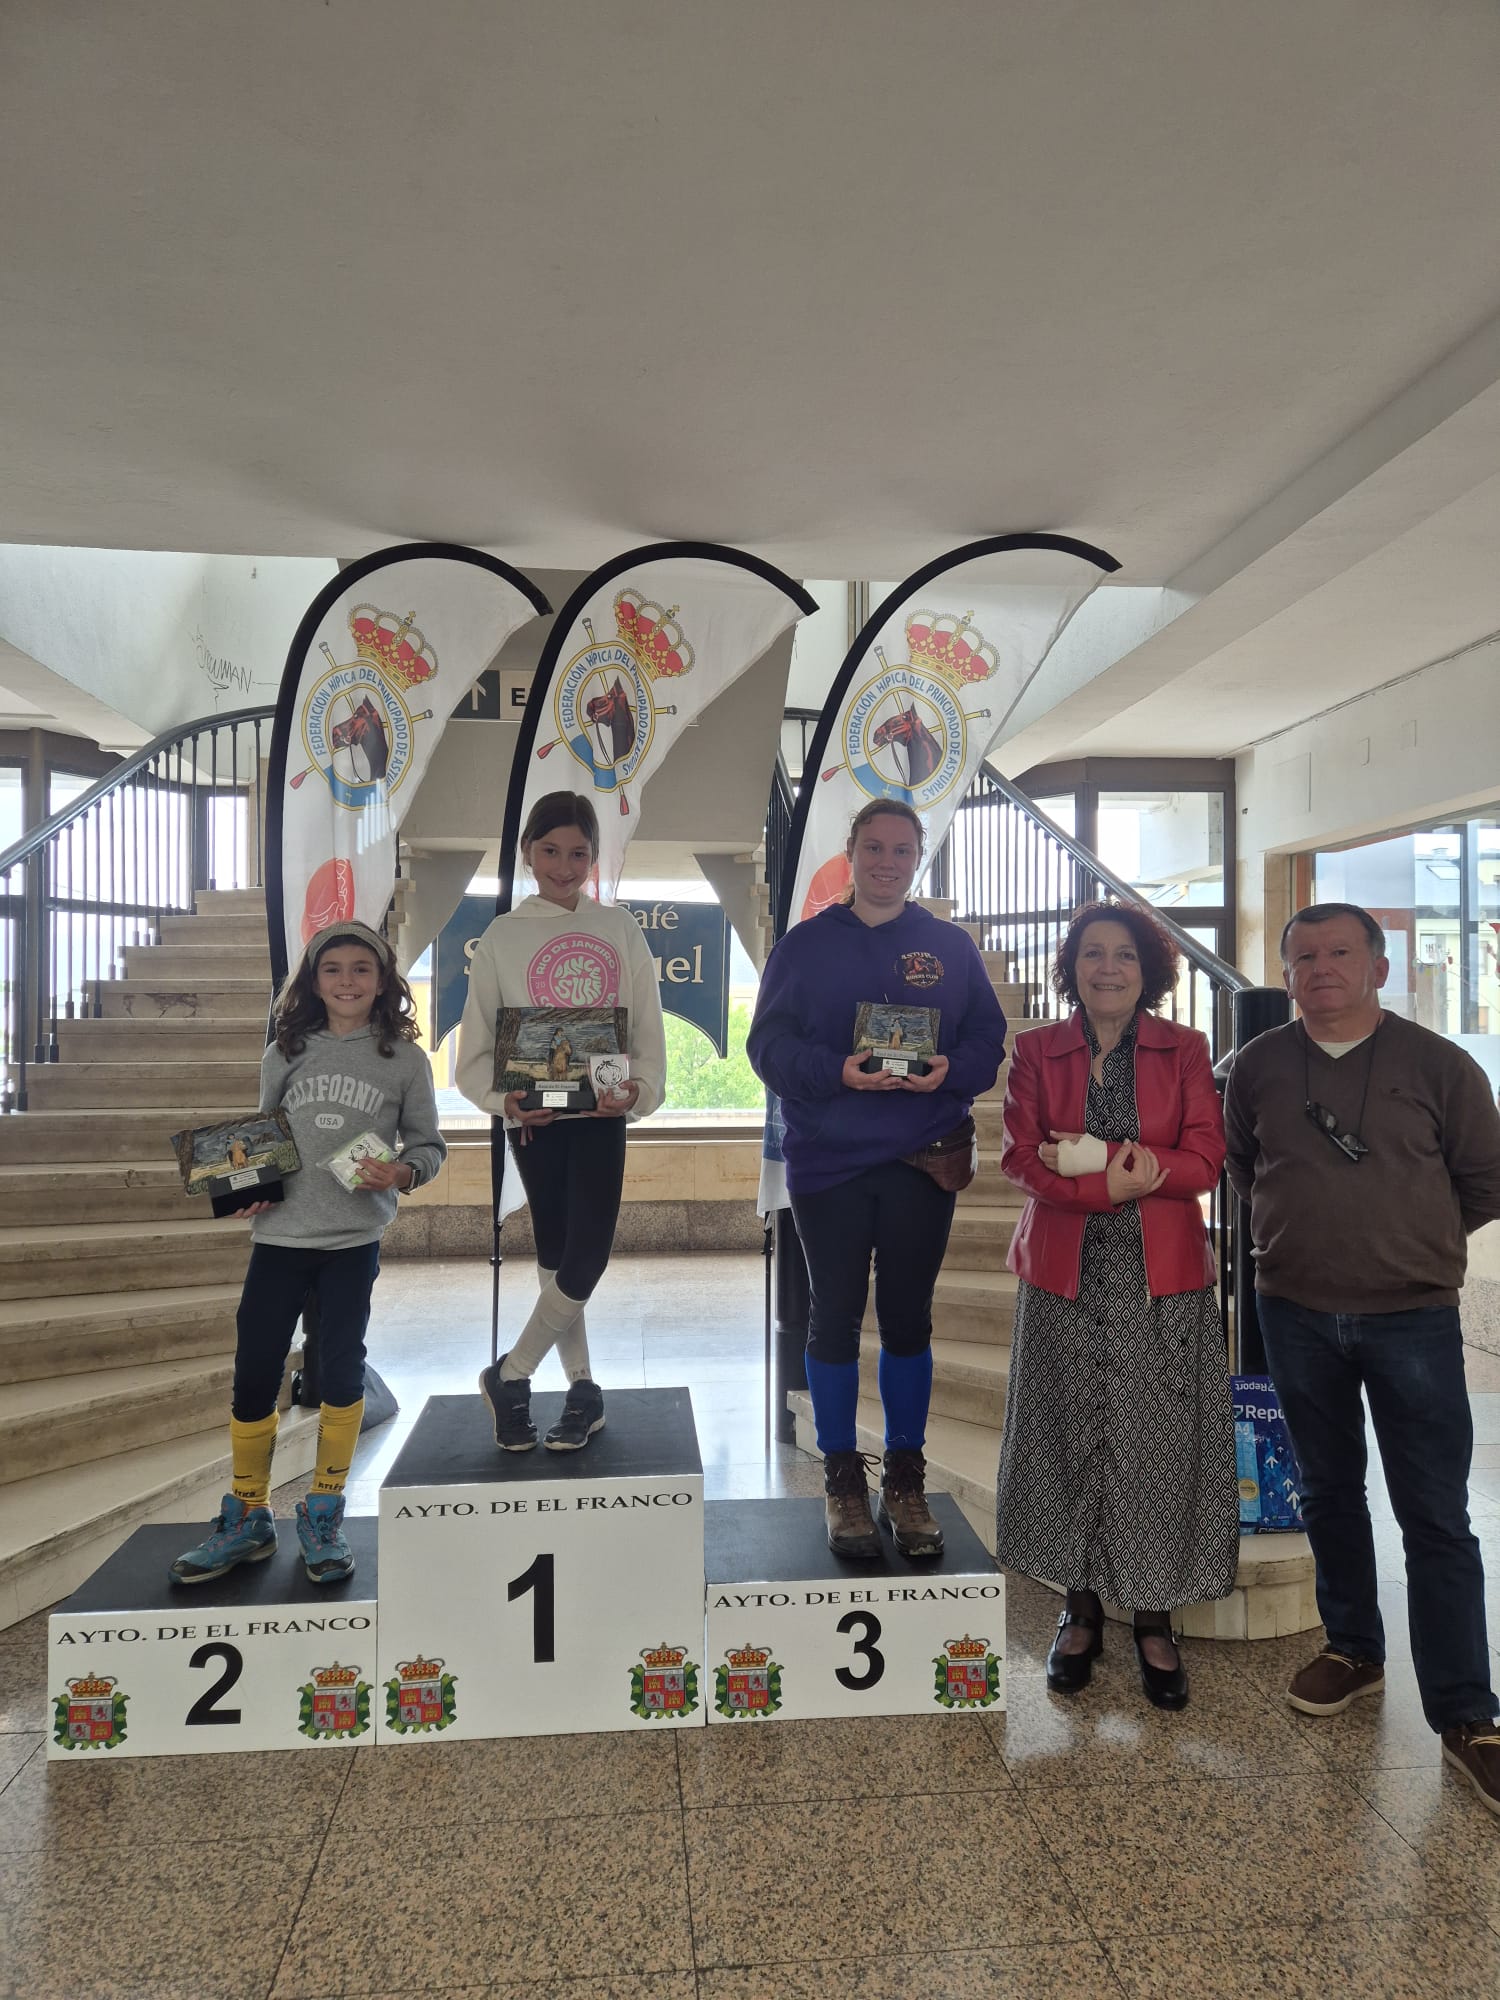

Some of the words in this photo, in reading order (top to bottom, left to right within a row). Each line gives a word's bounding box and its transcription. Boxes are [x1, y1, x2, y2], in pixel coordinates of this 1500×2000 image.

[562, 663, 587, 729] FEDERACIÓN
[585, 649, 612, 667] HÍPICA
[614, 649, 631, 667] DEL
[630, 663, 649, 730] PRCIPADO
[876, 671, 907, 693] HÍPICA
[909, 674, 925, 692] DEL
[309, 689, 331, 756] FEDERACIÓN
[327, 671, 356, 692] HÍPICA
[360, 668, 377, 684] DEL
[377, 679, 408, 740] PRINCIPADO
[396, 741, 408, 757] DE
[848, 691, 877, 755] FEDERACIÓN
[926, 684, 960, 739] PRINCIPADO
[950, 741, 960, 755] DE
[922, 757, 958, 800] ASTURIAS
[535, 954, 552, 975] RIO
[551, 942, 570, 954] DE
[571, 940, 615, 969] JANEIRO
[554, 956, 602, 978] DANCE
[285, 1073, 385, 1120] CALIFORNIA
[319, 1117, 338, 1126] USA
[1235, 1382, 1267, 1392] Report
[1235, 1423, 1250, 1435] A4
[394, 1503, 479, 1518] AYTO.
[490, 1500, 528, 1514] DE
[536, 1498, 568, 1512] EL
[575, 1493, 693, 1511] FRANCO
[507, 1553, 555, 1663] 1
[713, 1593, 797, 1608] AYTO.
[805, 1591, 841, 1605] DE
[850, 1590, 879, 1603] EL
[887, 1586, 1001, 1602] FRANCO
[57, 1629, 148, 1645] AYTO.
[157, 1626, 197, 1641] DE
[206, 1624, 240, 1638] EL
[247, 1616, 371, 1636] FRANCO
[834, 1610, 885, 1691] 3
[185, 1642, 243, 1726] 2
